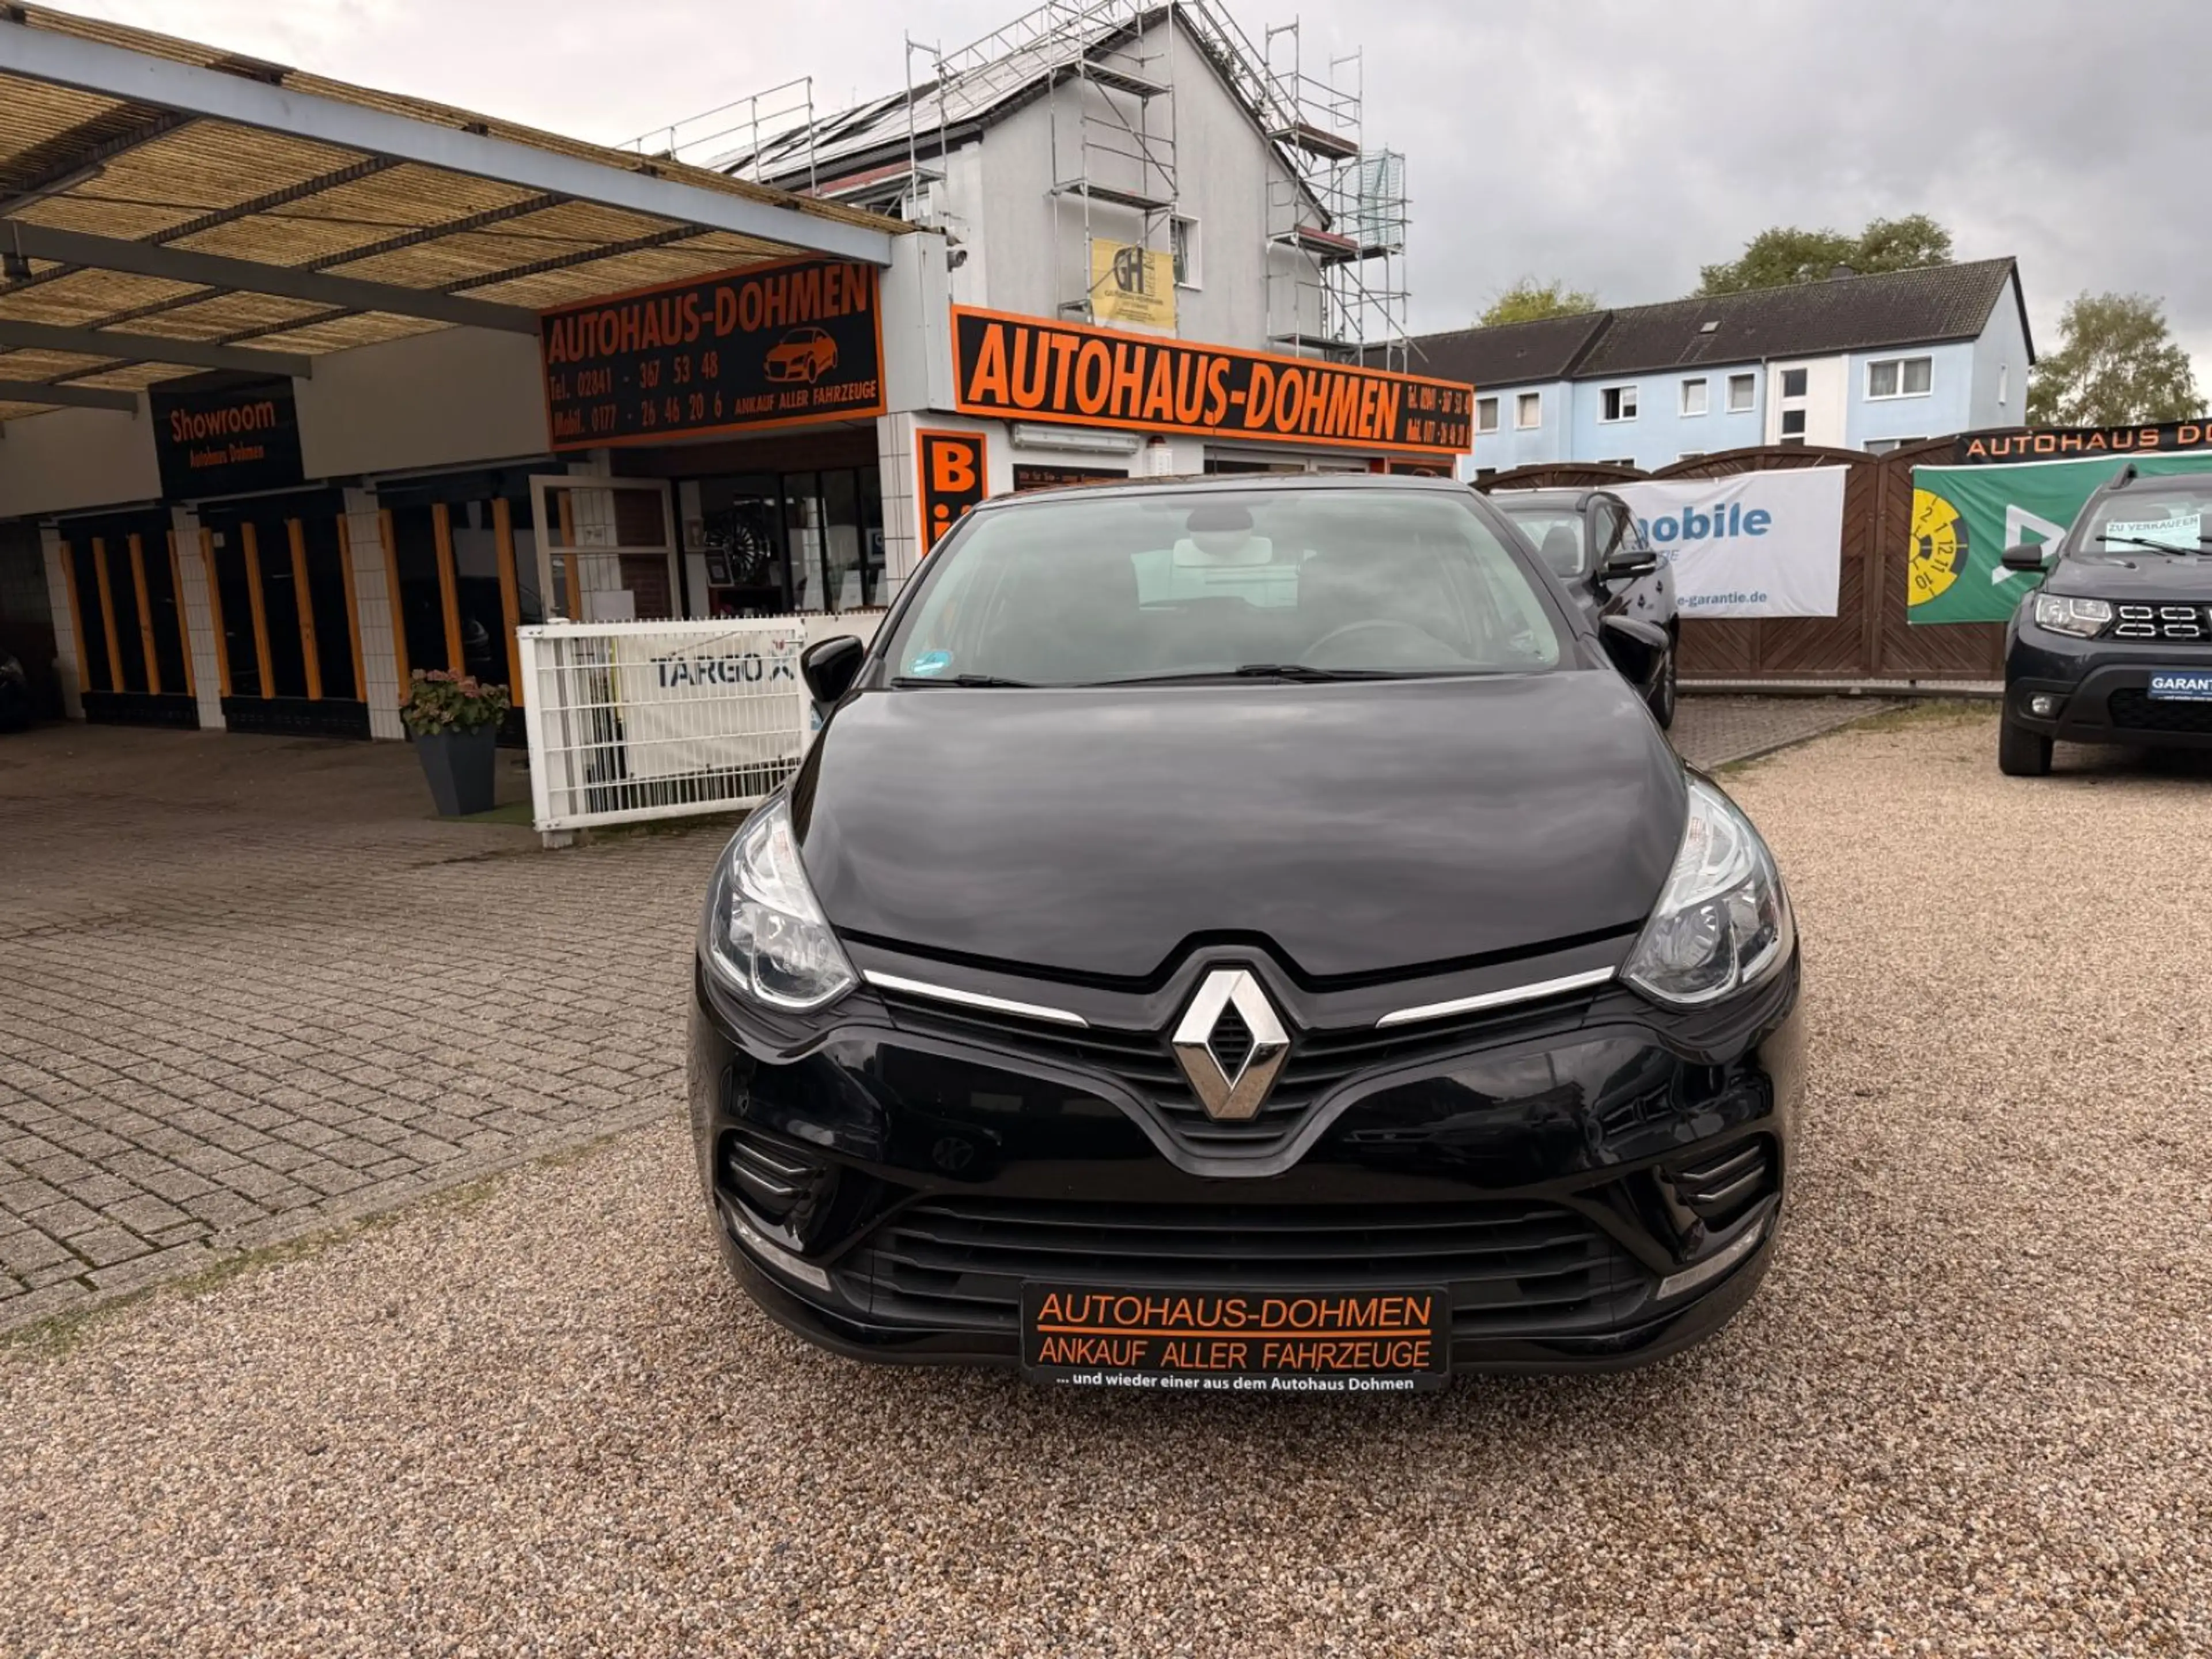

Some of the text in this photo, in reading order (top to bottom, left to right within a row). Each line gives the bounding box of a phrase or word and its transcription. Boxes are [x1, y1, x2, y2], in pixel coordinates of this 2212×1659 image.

[548, 263, 866, 363] AUTOHAUS-DOHMEN
[550, 373, 570, 400] Tel.
[577, 367, 611, 397] 02841
[639, 359, 660, 388] 367
[673, 355, 690, 384] 53
[701, 351, 718, 379] 48
[968, 323, 1400, 440] AUTOHAUS-DOHMEN
[591, 404, 616, 432] 0177
[641, 400, 656, 427] 26
[665, 396, 680, 423] 46
[689, 393, 704, 421] 20
[714, 390, 723, 418] 6
[735, 380, 877, 415] ANKAUF ALLER FAHRZEUGE
[171, 402, 276, 442] Showroom
[1966, 429, 2160, 456] AUTOHAUS
[1920, 506, 1933, 523] 2
[1933, 522, 1948, 533] 1
[2108, 517, 2198, 532] ZU VERKAUFEN
[1937, 539, 1955, 555] 12
[1914, 571, 1933, 590] 10
[1930, 558, 1949, 574] 11
[650, 653, 762, 688] TARGO
[1037, 1293, 1431, 1328] AUTOHAUS-DOHMEN
[1039, 1336, 1432, 1370] ANKAUF ALLER FAHRZEUGE
[1072, 1372, 1103, 1385] und
[1105, 1373, 1158, 1388] wieder
[1160, 1374, 1200, 1389] einer
[1203, 1377, 1230, 1391] aus
[1233, 1376, 1267, 1390] dem
[1270, 1377, 1345, 1392] Autohaus
[1348, 1377, 1414, 1391] Dohmen
